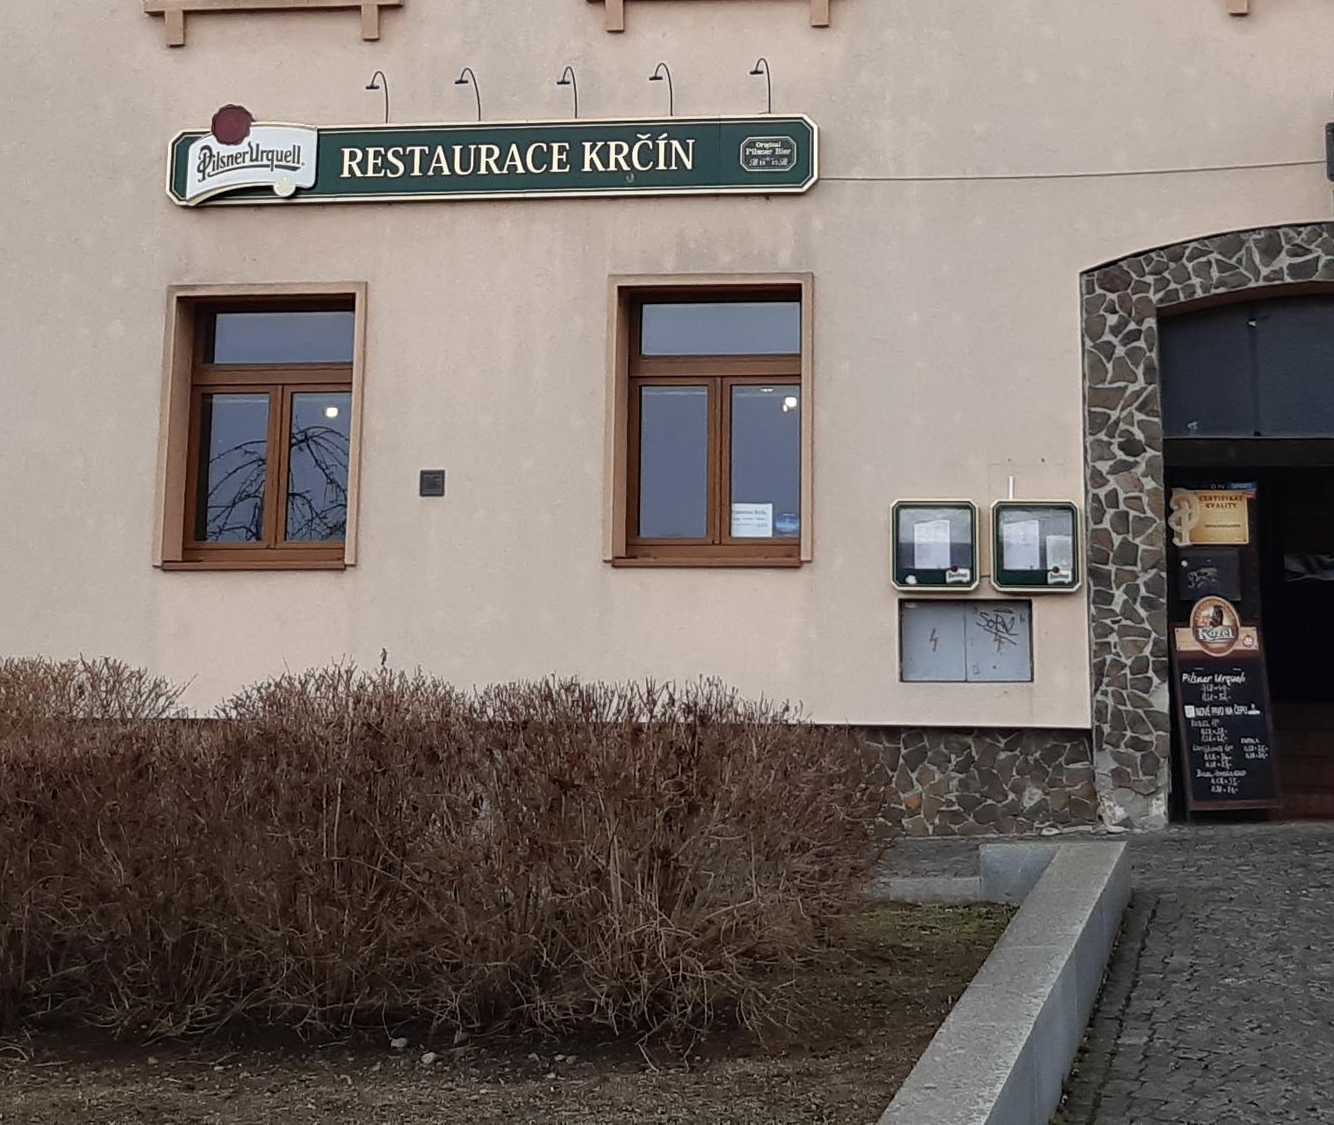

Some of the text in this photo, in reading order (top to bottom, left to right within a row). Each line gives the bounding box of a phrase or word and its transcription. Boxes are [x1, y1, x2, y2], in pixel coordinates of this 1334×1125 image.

[197, 141, 301, 182] Pilsner Urquell
[340, 132, 696, 178] RESTAURACE KRČÍN
